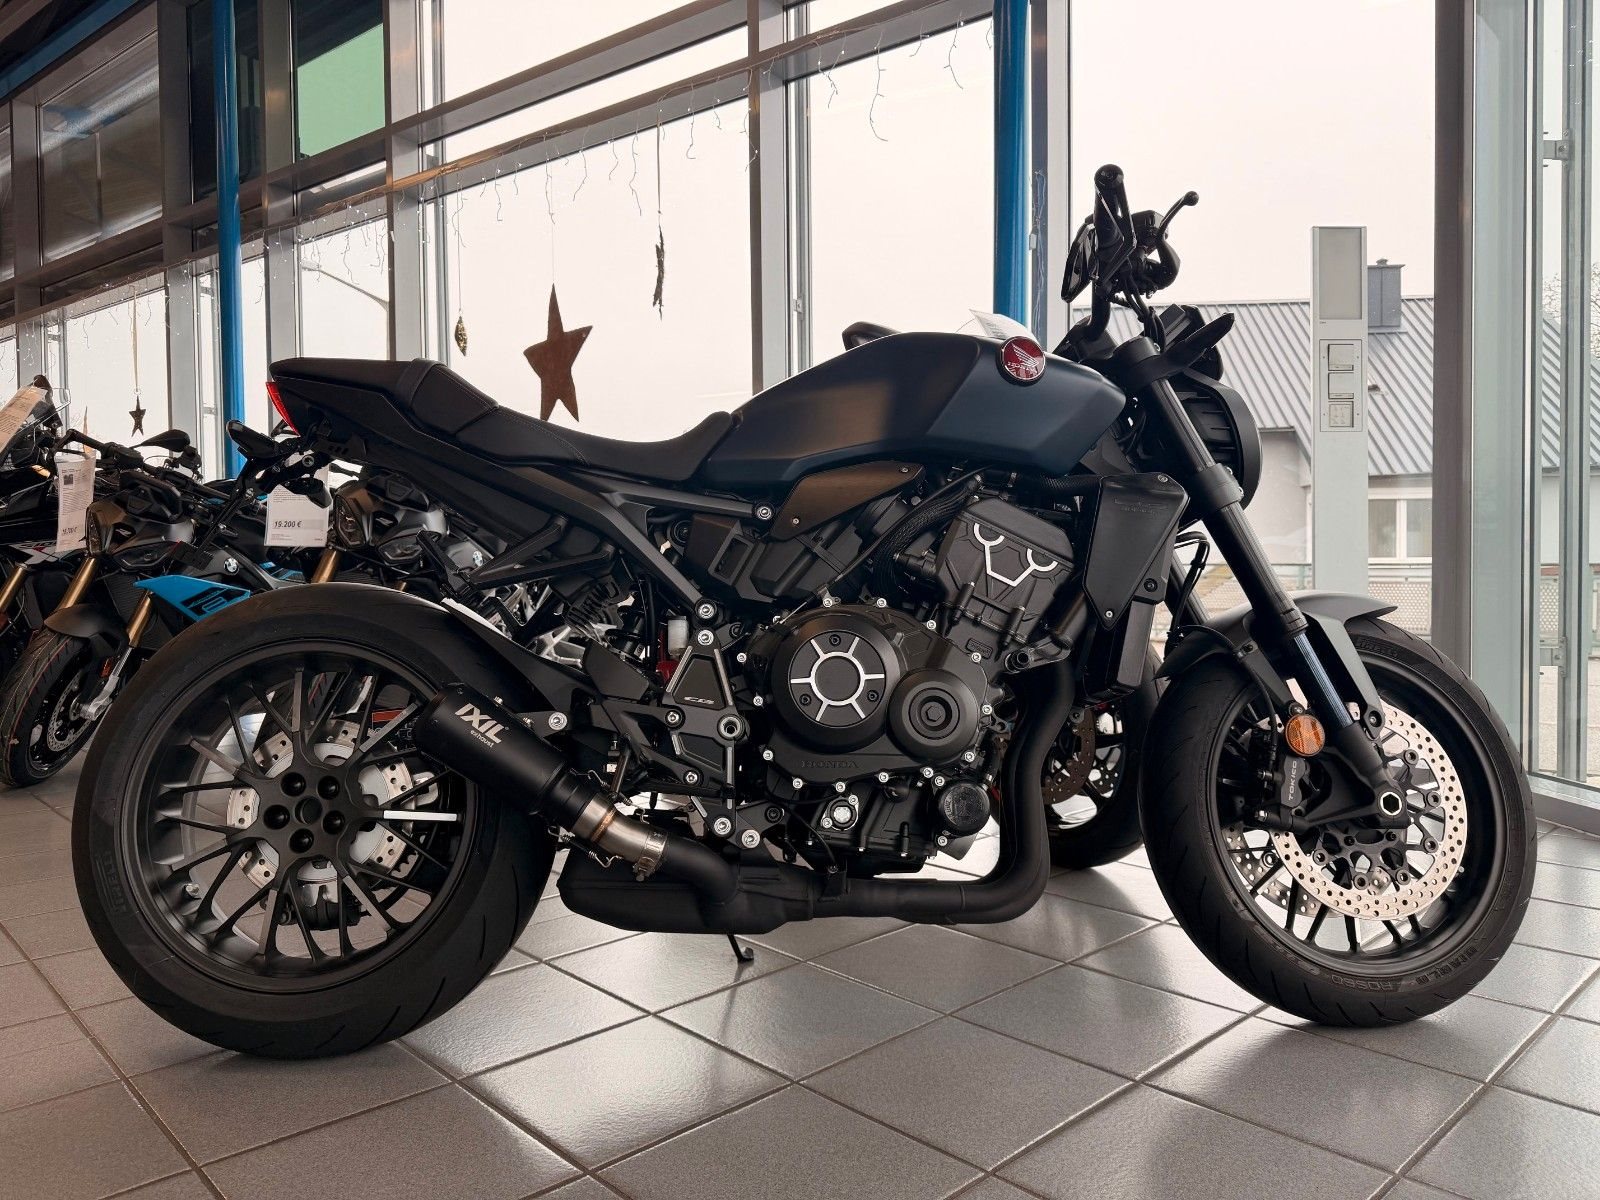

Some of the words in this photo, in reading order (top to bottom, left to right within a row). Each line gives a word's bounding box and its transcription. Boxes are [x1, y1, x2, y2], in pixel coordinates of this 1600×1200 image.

[274, 520, 296, 528] 19.200
[296, 520, 302, 528] €
[455, 703, 505, 744] IXIL
[470, 729, 495, 748] exhaust
[801, 760, 860, 769] HONDA
[1288, 760, 1298, 801] TOKICO
